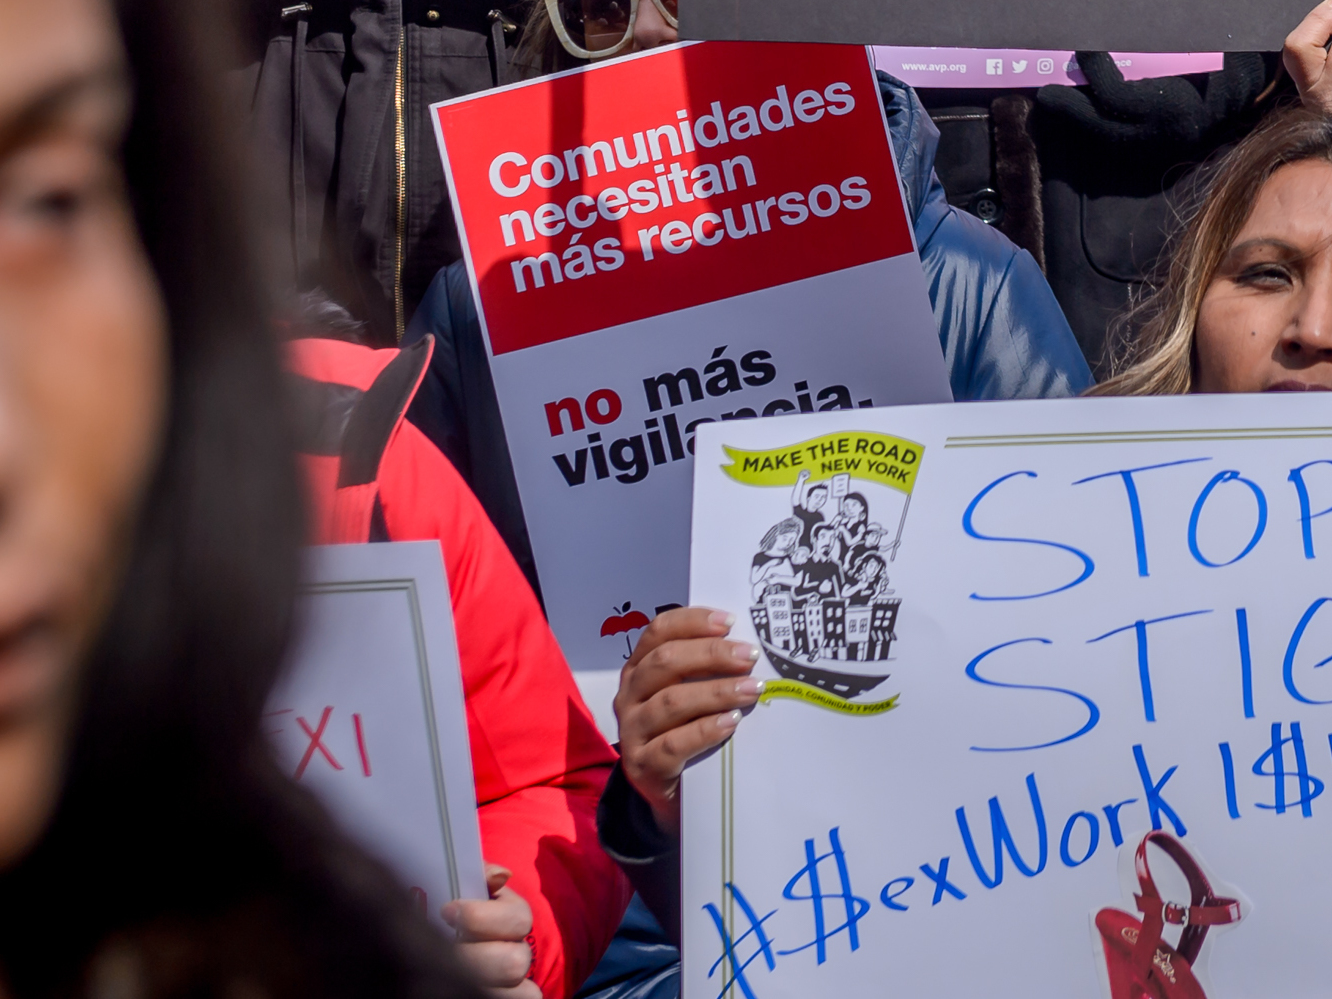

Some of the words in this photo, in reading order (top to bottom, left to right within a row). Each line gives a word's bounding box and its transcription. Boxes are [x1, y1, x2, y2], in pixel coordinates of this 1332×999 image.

[901, 60, 968, 74] www.avp.org
[488, 81, 856, 198] Comunidades
[499, 151, 758, 248] necesitan
[510, 233, 626, 294] más
[637, 174, 873, 262] recursos
[543, 387, 623, 438] no
[641, 345, 777, 413] más
[742, 448, 803, 473] MAKE
[804, 438, 850, 461] THE
[855, 438, 917, 465] ROAD
[821, 458, 861, 475] NEW
[867, 458, 912, 484] YORK
